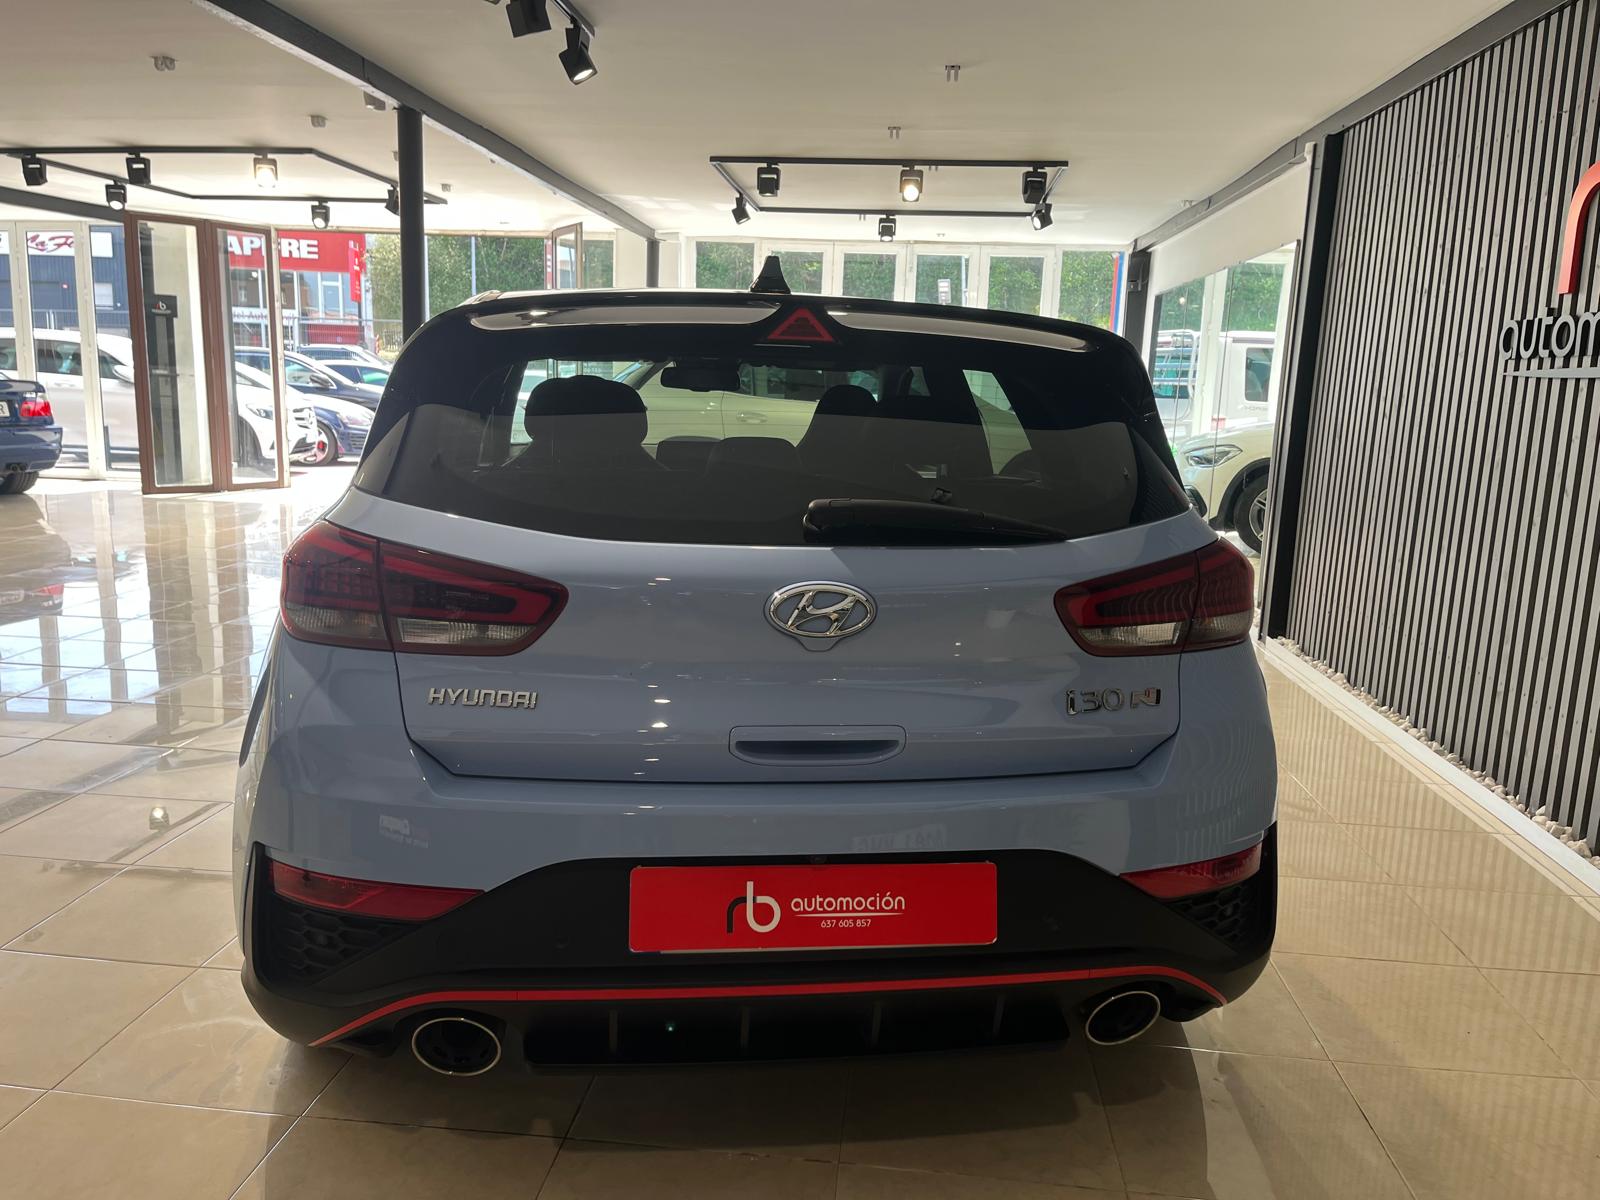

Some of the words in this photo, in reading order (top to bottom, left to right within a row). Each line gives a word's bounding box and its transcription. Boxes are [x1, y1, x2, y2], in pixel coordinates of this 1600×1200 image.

[428, 688, 537, 709] HYUNDAI
[1066, 689, 1124, 715] i30
[1130, 688, 1161, 709] N
[791, 892, 905, 912] automoción
[821, 920, 836, 928] 637
[838, 919, 854, 927] 605
[856, 919, 871, 927] 857
